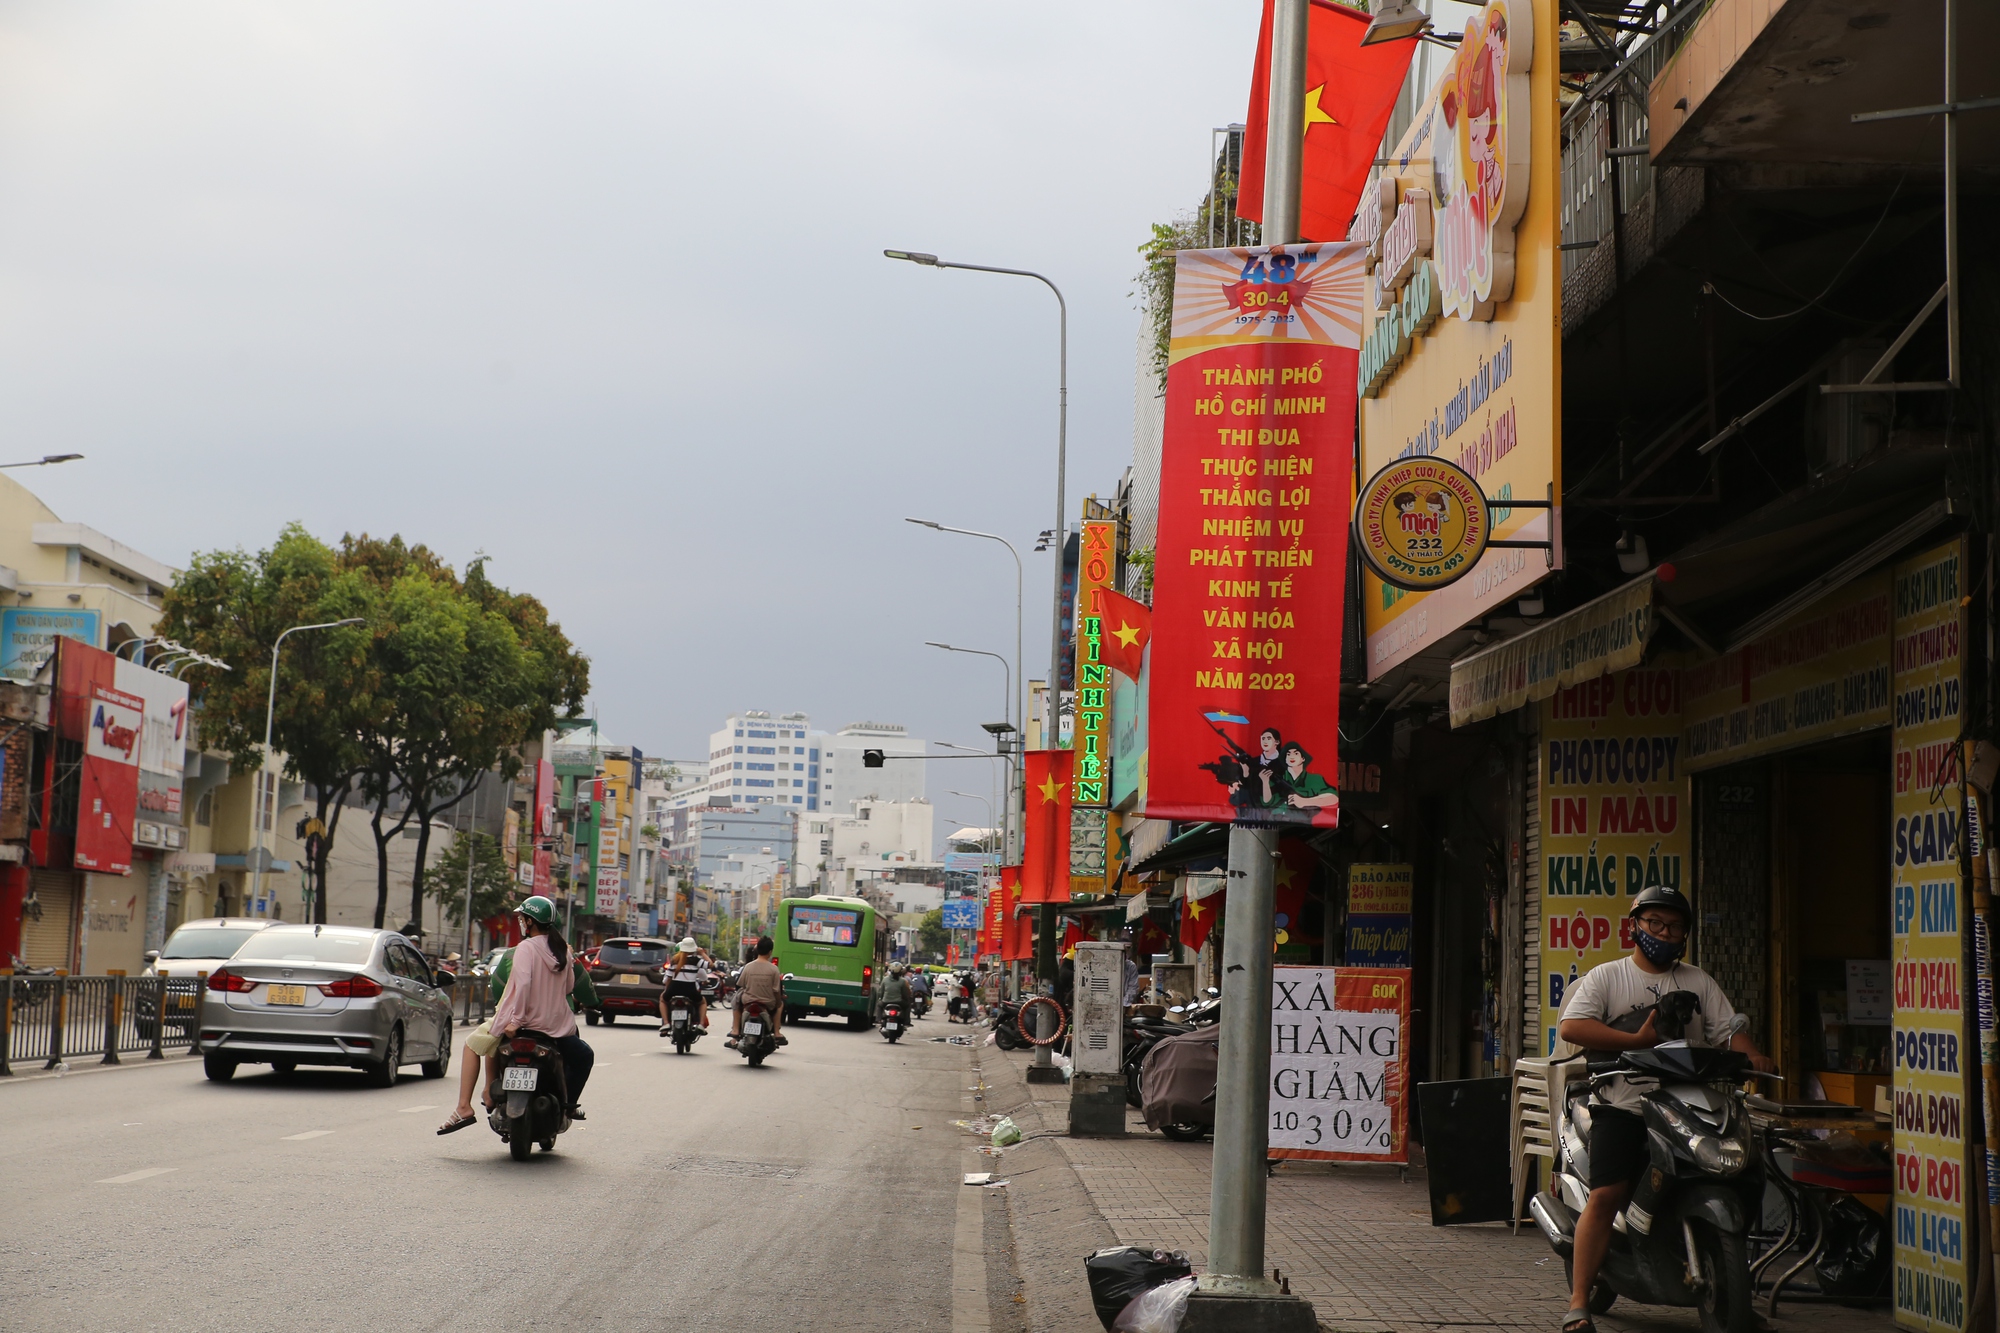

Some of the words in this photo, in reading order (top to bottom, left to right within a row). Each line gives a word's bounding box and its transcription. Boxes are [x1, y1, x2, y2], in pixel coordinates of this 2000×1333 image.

[1241, 254, 1296, 284] 48
[1242, 291, 1289, 307] 30-4
[1235, 316, 1260, 324] 1975
[1270, 315, 1295, 323] 2023
[1358, 304, 1399, 400] QUẢNG
[1403, 257, 1431, 339] CÁO
[1203, 364, 1274, 385] THÀNH
[1281, 359, 1323, 384] PHỐ
[1492, 335, 1513, 393] MỚI
[1195, 391, 1225, 416] HỒ
[1231, 393, 1266, 415] CHÍ
[1273, 397, 1326, 414] MINH
[1218, 429, 1252, 446] THI
[1258, 429, 1300, 446] ĐUA
[1480, 409, 1492, 475] SỐ
[1495, 397, 1517, 462] NHÀ
[1200, 456, 1257, 481] THỰC
[1263, 455, 1313, 480] HIỆN
[1387, 468, 1412, 488] THIỆP
[1415, 465, 1437, 478] CƯỚI
[1438, 470, 1446, 481] &
[1200, 482, 1272, 506] THẮNG
[1280, 486, 1310, 510] LỢI
[1371, 484, 1391, 508] TNHH
[1447, 475, 1474, 504] QUẢNG
[1368, 510, 1380, 522] TY
[1466, 505, 1480, 523] CÁO
[1203, 516, 1271, 541] NHIỆM
[1278, 519, 1304, 541] VỤ
[1369, 522, 1385, 548] CÔNG
[1190, 545, 1247, 567] PHÁT
[1252, 541, 1313, 567] TRIỂN
[1407, 538, 1443, 550] 232
[1407, 550, 1416, 558] LÝ
[1434, 549, 1443, 557] TỔ
[1387, 555, 1416, 575] 0979
[1418, 565, 1442, 576] 562
[1444, 553, 1465, 571] 493
[1208, 580, 1260, 598] KINH
[1268, 573, 1294, 598] TẾ
[1923, 565, 1937, 610] XIN
[1940, 550, 1958, 611] VIỆC
[1203, 607, 1246, 628] VĂN
[1252, 607, 1295, 629] HÓA
[1212, 637, 1241, 659] XÃ
[1247, 639, 1283, 664] HỘI
[1896, 638, 1904, 674] IN
[1919, 619, 1945, 670] THUẬT
[1947, 611, 1959, 659] SỐ
[1196, 667, 1243, 689] NĂM
[1249, 673, 1295, 690] 2023
[1623, 658, 1681, 718] CƯỚI
[1896, 684, 1926, 728] ĐÓNG
[1929, 675, 1942, 721] LÒ
[1944, 678, 1959, 716] XO
[1549, 736, 1679, 785] PHOTOCOPY
[1896, 742, 1911, 794] ÉP
[1916, 741, 1958, 796] NHỰA
[1719, 786, 1755, 803] 232
[1551, 797, 1588, 835] IN
[1599, 788, 1678, 834] MÀU
[1895, 811, 1956, 867] SCAN
[1360, 868, 1384, 883] BẢO
[1386, 871, 1410, 883] ANH
[1548, 840, 1617, 896] KHẮC
[1626, 842, 1681, 895] DẤU
[598, 877, 619, 886] BẾP
[1352, 884, 1374, 899] 236
[1376, 886, 1384, 899] Lý
[1385, 886, 1399, 897] Thái
[1400, 885, 1409, 897] Tổ
[525, 902, 540, 914] Grab
[1895, 875, 1915, 934] ÉP
[1920, 882, 1957, 934] KIM
[808, 921, 821, 933] 14
[1551, 911, 1610, 957] HỘP
[1351, 927, 1381, 957] Thiệp
[1383, 927, 1408, 951] Cưới
[278, 986, 295, 994] 51G
[1895, 944, 1917, 1009] CẮT
[1920, 961, 1960, 1010] DECAL
[1273, 972, 1333, 1011] XẢ
[1372, 984, 1398, 999] 60K
[1273, 1016, 1398, 1057] HÀNG
[1895, 1031, 1959, 1074] POSTER
[505, 1079, 535, 1089] 683.93
[509, 1069, 532, 1079] 62-M1
[1273, 1061, 1385, 1102] GIẢM
[1273, 1111, 1299, 1131] 10
[1895, 1082, 1925, 1133] HÓA
[1928, 1094, 1960, 1140] ĐƠN
[1896, 1146, 1921, 1194] TỜ
[1926, 1158, 1961, 1204] RƠI
[1897, 1206, 1915, 1248] IN
[1922, 1212, 1961, 1264] LỊCH
[1897, 1263, 1914, 1312] BÌA
[1916, 1270, 1931, 1329] MẠ
[1933, 1270, 1963, 1331] VÀNG
